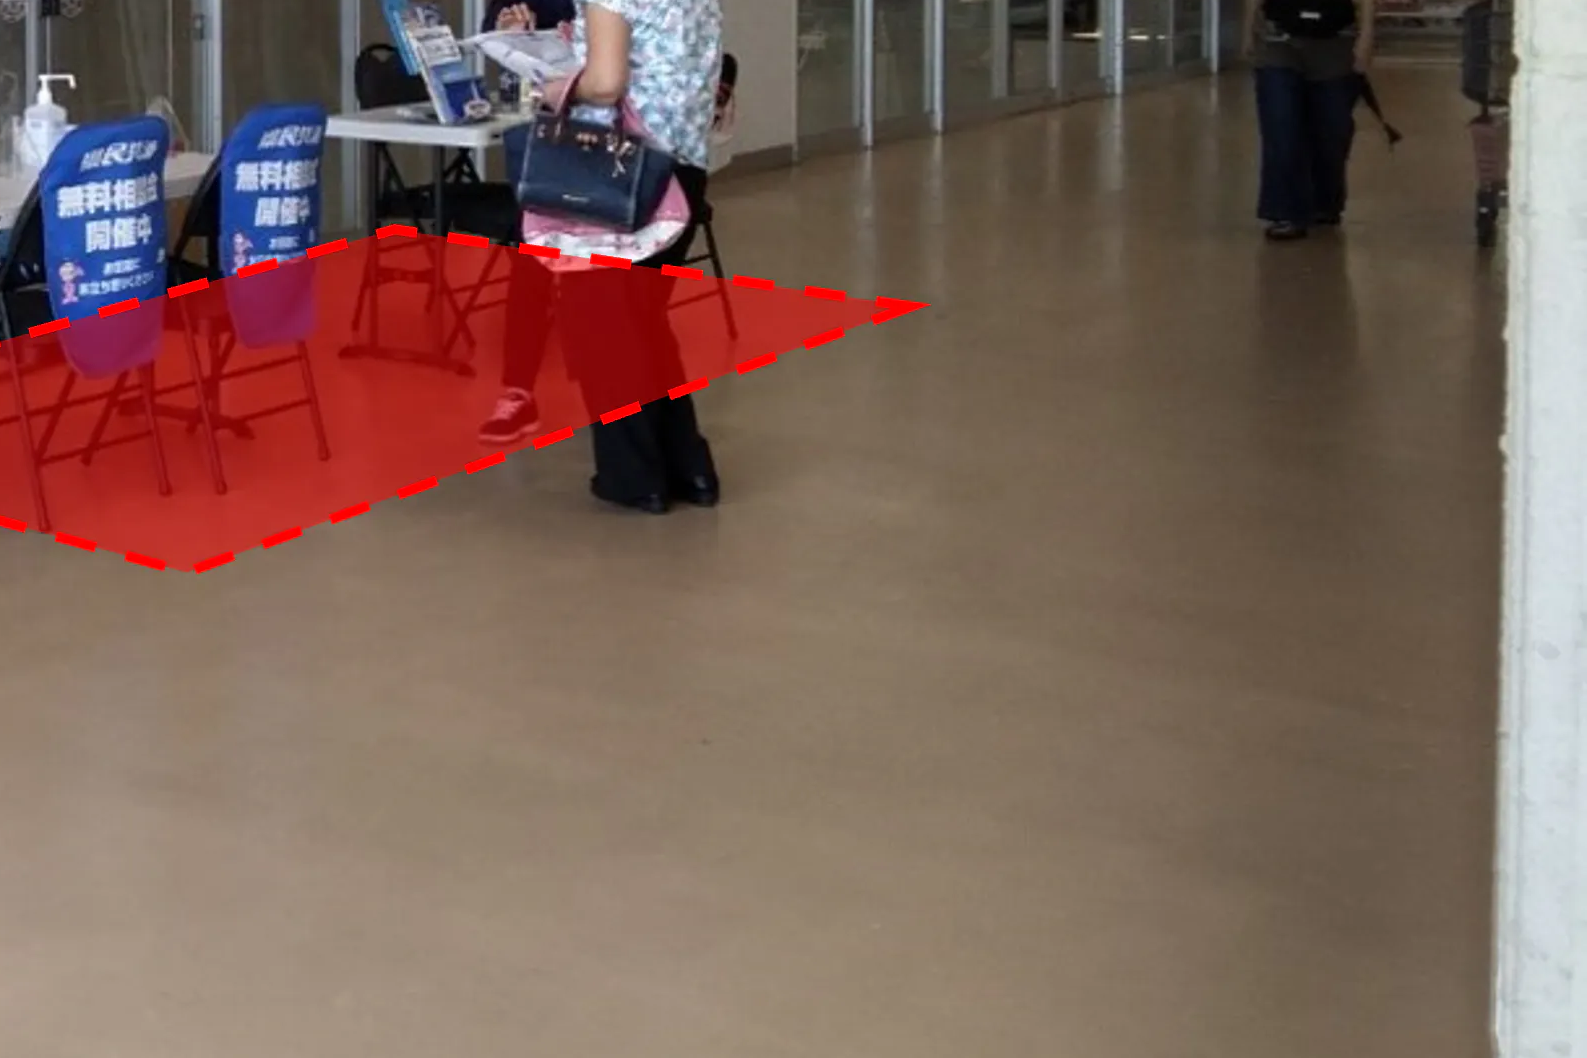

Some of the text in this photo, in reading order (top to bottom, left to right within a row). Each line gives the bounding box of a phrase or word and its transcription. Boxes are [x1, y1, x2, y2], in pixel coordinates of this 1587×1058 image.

[56, 171, 159, 219] 無料相談会
[85, 213, 153, 254] 開催中
